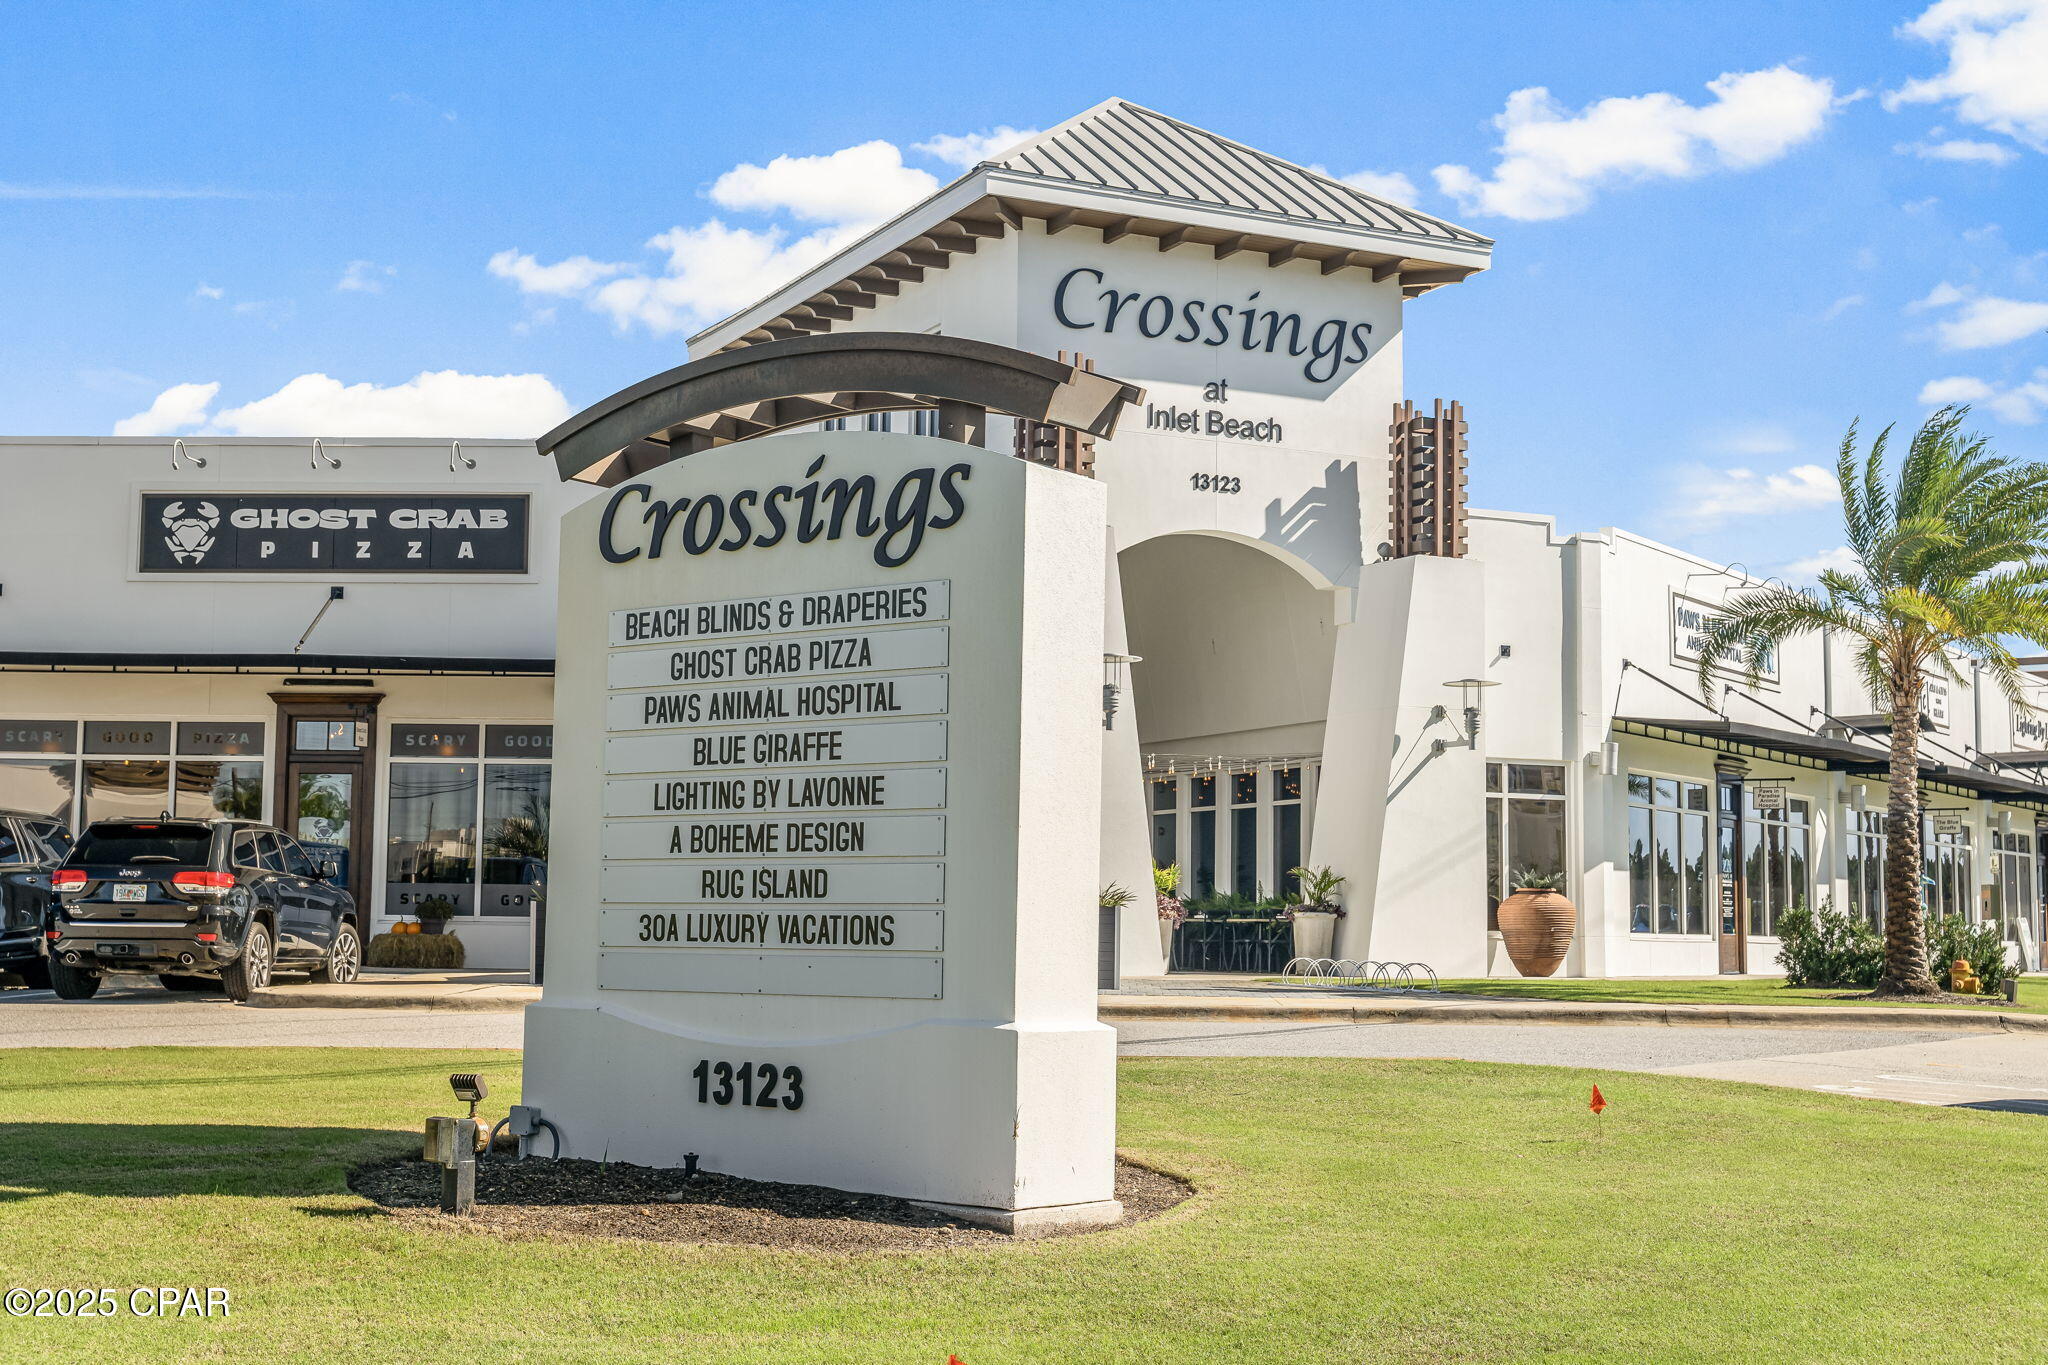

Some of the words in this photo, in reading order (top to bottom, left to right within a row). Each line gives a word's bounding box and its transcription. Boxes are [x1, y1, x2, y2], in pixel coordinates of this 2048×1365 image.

[1053, 267, 1373, 384] Crossings
[1203, 379, 1229, 402] at
[1147, 403, 1200, 434] Inlet
[1205, 409, 1283, 443] Beach
[1191, 472, 1242, 494] 13123
[230, 508, 378, 530] GHOST
[388, 508, 509, 530] CRAB
[599, 454, 971, 568] Crossings
[260, 541, 475, 559] PIZZA
[625, 608, 690, 641] BEACH
[696, 600, 771, 634] BLINDS
[778, 600, 795, 628] &
[802, 586, 928, 627] DRAPERIES
[1677, 606, 1700, 632] PAWS
[670, 647, 738, 681] GHOST
[744, 642, 801, 675] CRAB
[808, 637, 872, 671] PIZZA
[644, 692, 701, 725] PAWS
[708, 688, 790, 722] ANIMAL
[797, 681, 902, 717] HOSPITAL
[5, 730, 64, 743] SCARY
[102, 731, 154, 744] GOOD
[193, 732, 250, 745] PIZZA
[405, 734, 467, 747] SCARY
[693, 735, 746, 766] BLUE
[753, 730, 843, 763] GIRAFFE
[653, 780, 746, 811] LIGHTING
[752, 779, 781, 809] BY
[787, 775, 885, 808] LAVONNE
[669, 825, 683, 853] A
[690, 823, 779, 853] BOHEME
[786, 822, 865, 852] DESIGN
[118, 868, 141, 878] Jeep
[701, 869, 745, 899] RUG
[751, 868, 829, 899] ISLAND
[639, 914, 679, 942] 30A
[686, 914, 769, 944] LUXURY
[777, 914, 895, 946] VACATIONS
[692, 1059, 804, 1111] 13123
